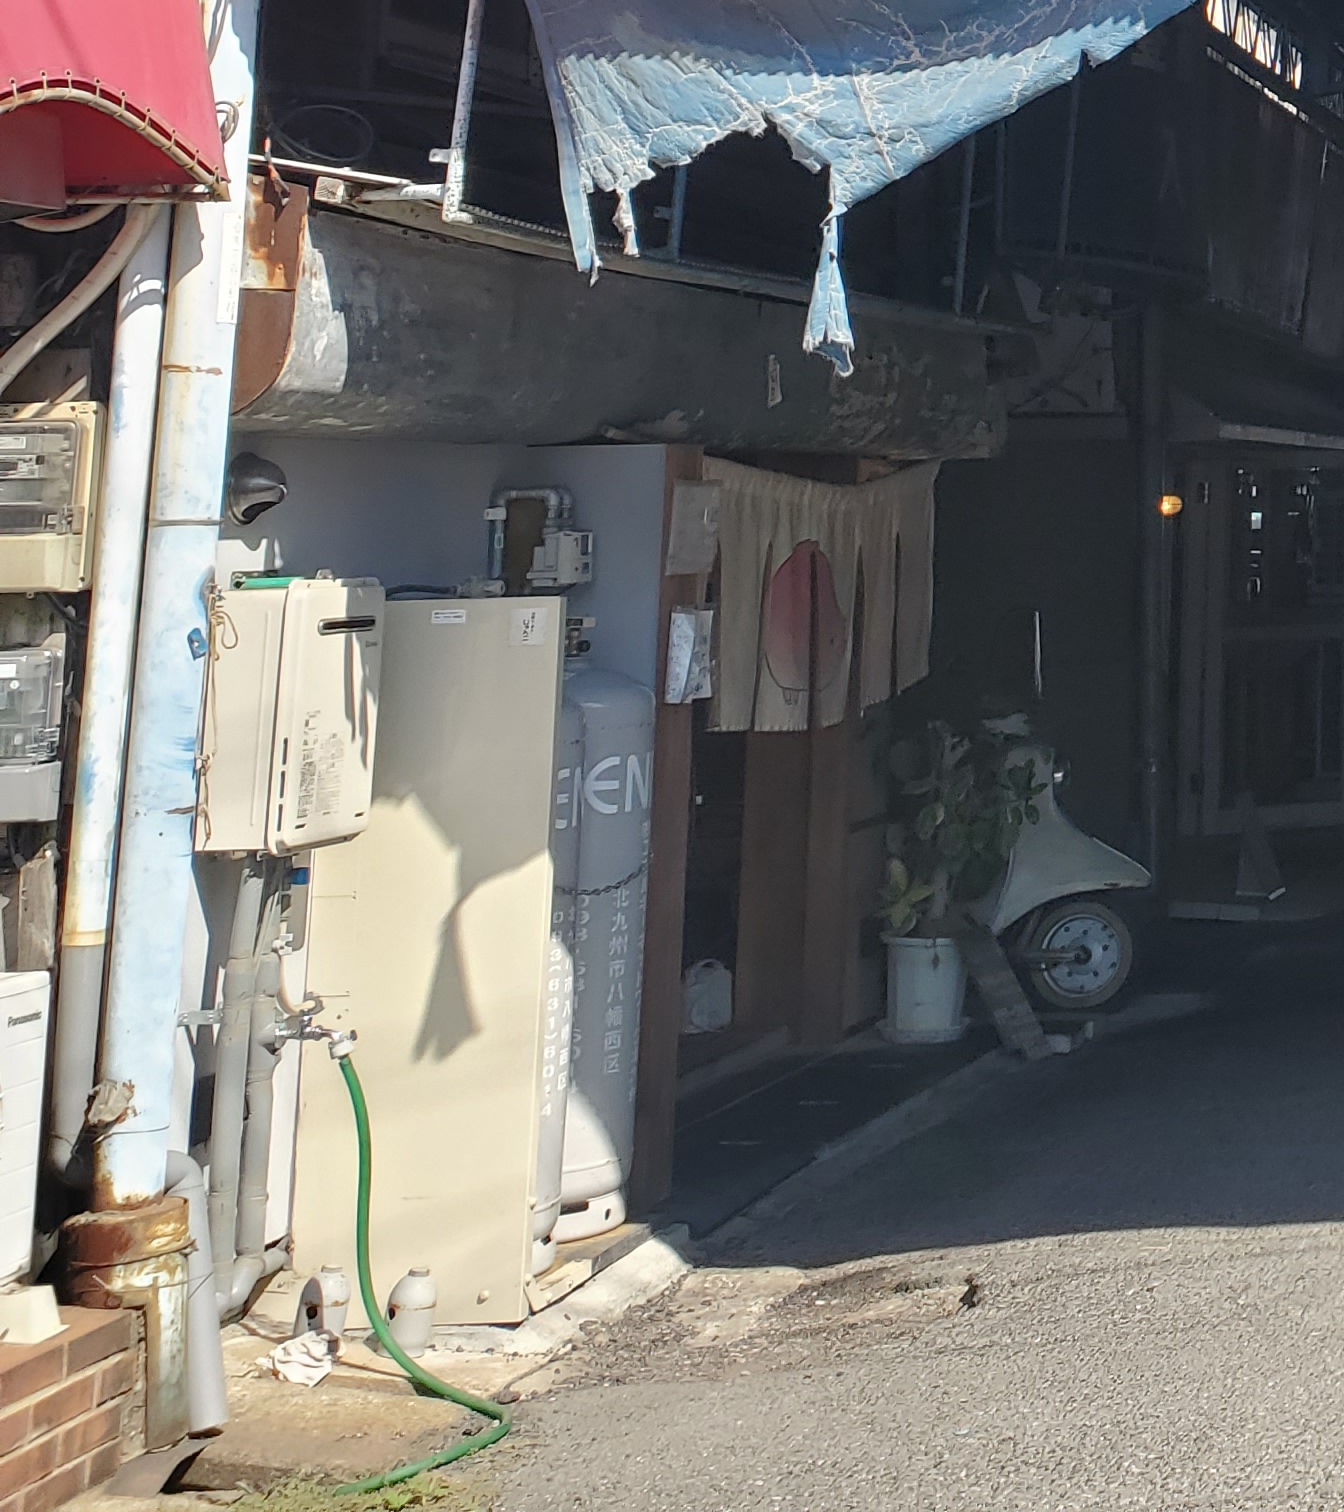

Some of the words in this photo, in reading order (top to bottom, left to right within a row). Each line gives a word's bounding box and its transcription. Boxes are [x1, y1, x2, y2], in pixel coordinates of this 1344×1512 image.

[603, 887, 630, 1075] 北九州市八幡西区
